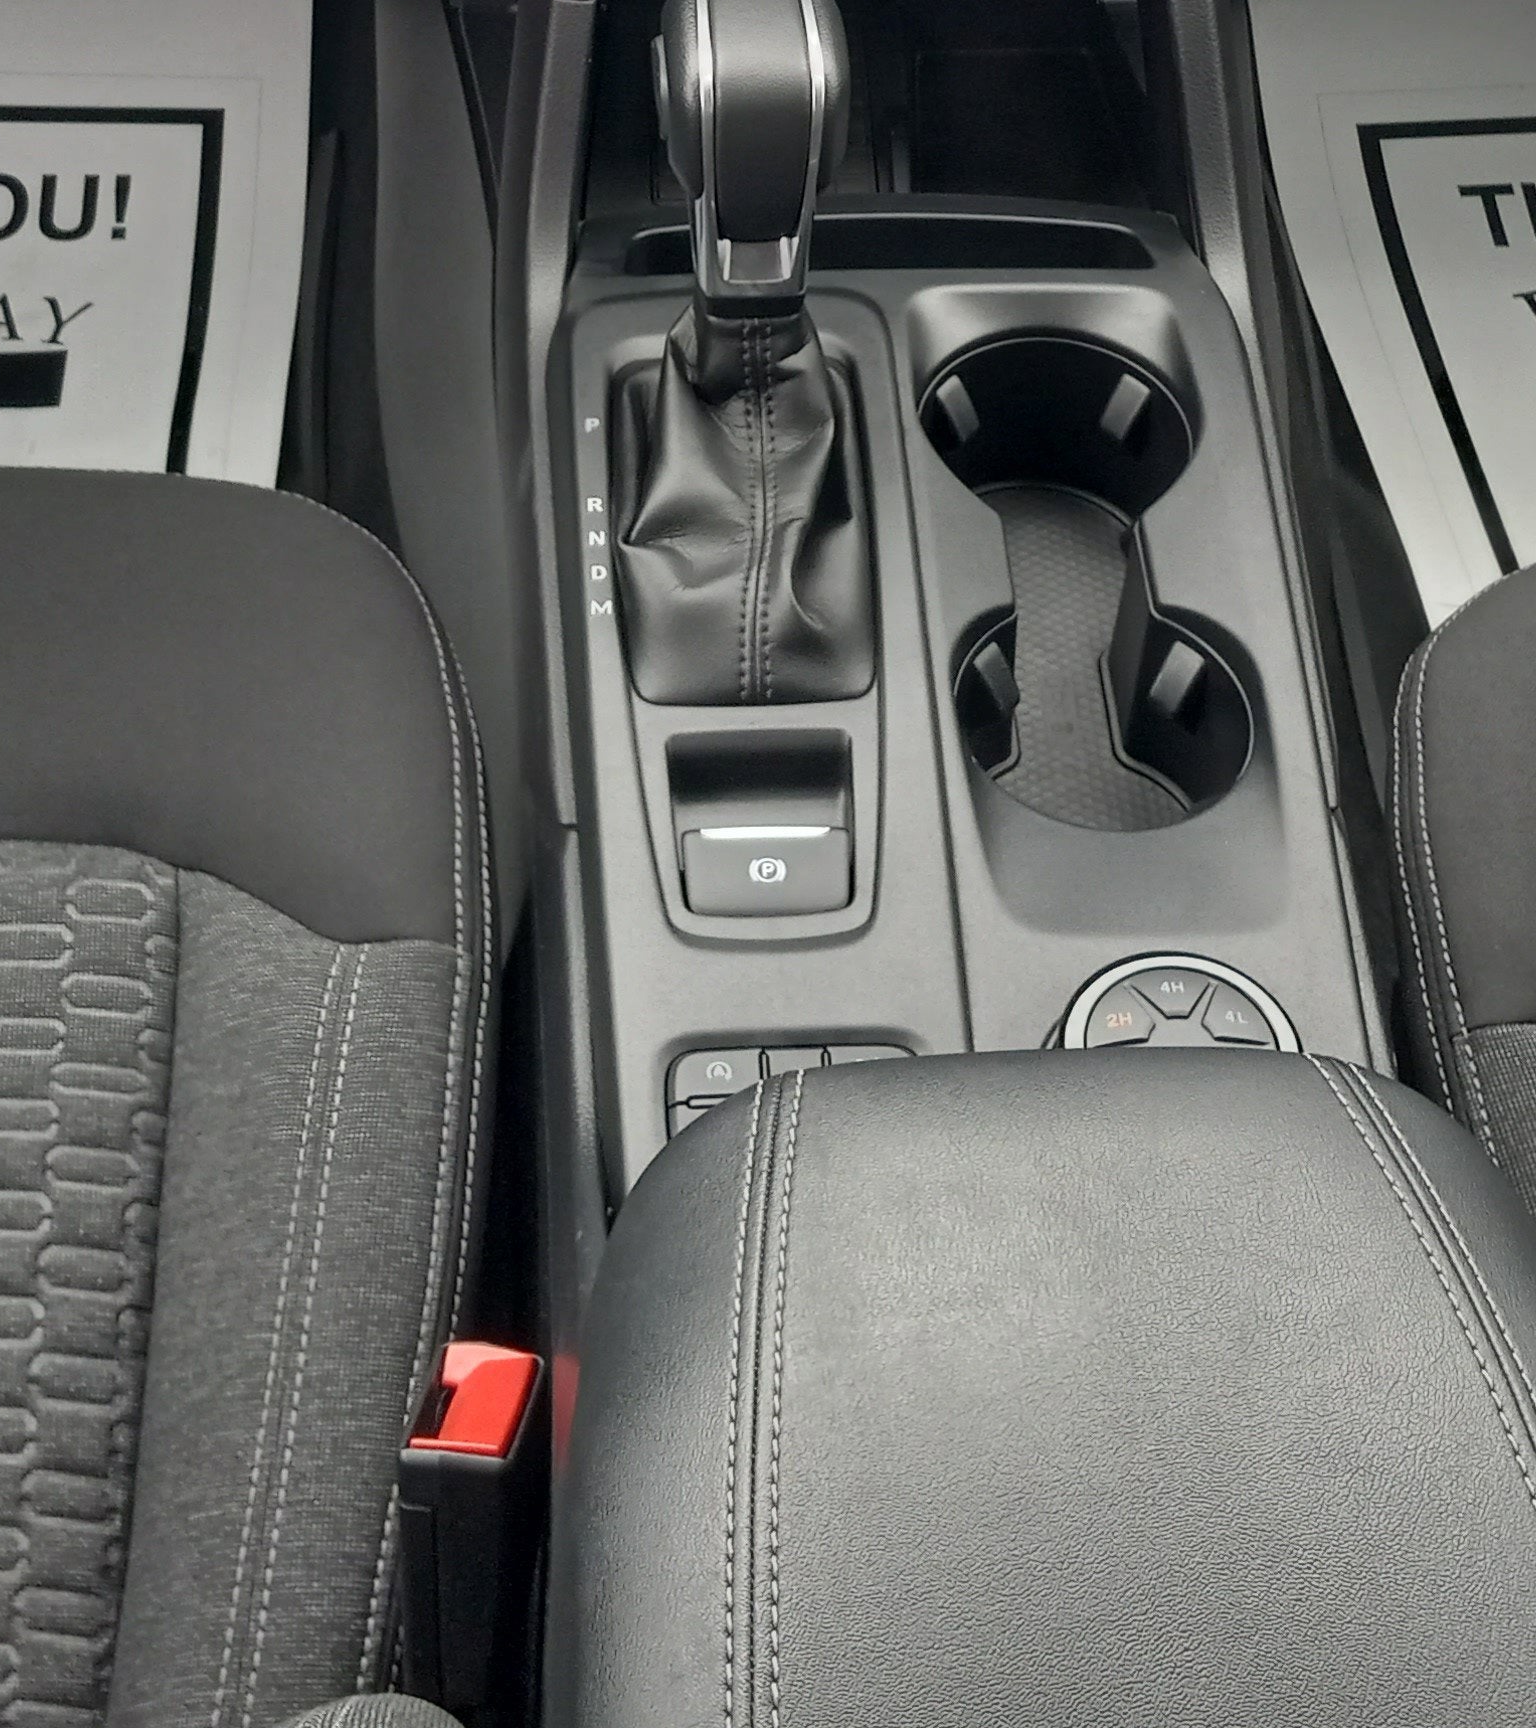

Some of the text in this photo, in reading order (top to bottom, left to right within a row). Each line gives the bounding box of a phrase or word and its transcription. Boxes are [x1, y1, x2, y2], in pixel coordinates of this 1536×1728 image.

[585, 418, 600, 433] P
[586, 497, 604, 513] R
[588, 531, 606, 545] N
[590, 565, 608, 579] D
[590, 600, 612, 616] M
[1160, 981, 1184, 993] 4H
[1106, 1012, 1133, 1029] 2H
[1225, 1010, 1249, 1024] 4L
